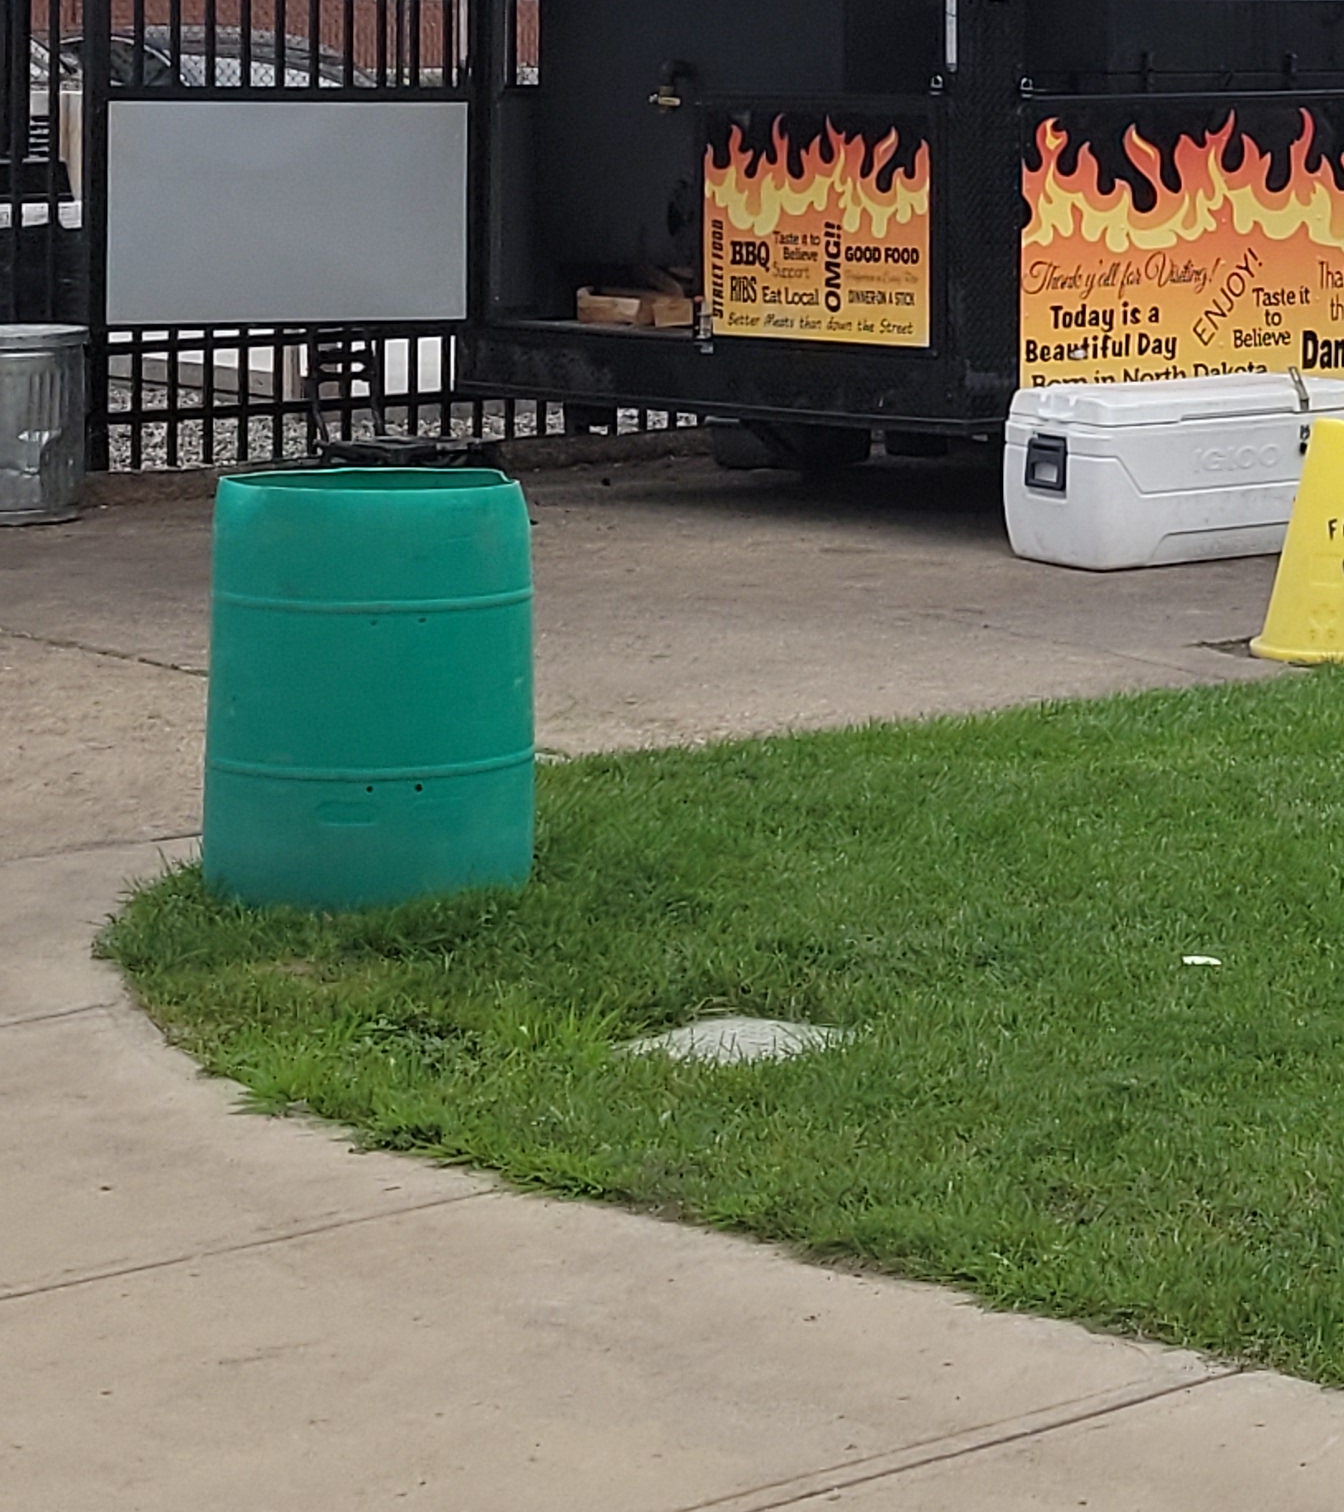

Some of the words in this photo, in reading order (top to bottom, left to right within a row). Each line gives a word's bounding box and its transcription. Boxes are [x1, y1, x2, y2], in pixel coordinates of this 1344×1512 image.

[730, 240, 770, 273] BBQ
[783, 247, 818, 262] Believe
[845, 246, 881, 263] GOOD
[884, 247, 920, 264] FOOD
[824, 221, 842, 313] OMG!!
[762, 286, 782, 305] Eat
[785, 287, 820, 306] Local
[1193, 248, 1263, 346] ENJOY!
[1252, 288, 1296, 307] Taste
[1299, 286, 1310, 305] it
[1050, 303, 1115, 332] Today
[1122, 301, 1141, 326] is
[1148, 306, 1160, 324] a
[1265, 309, 1282, 327] to
[1025, 333, 1130, 363] Beautiful
[1137, 333, 1177, 361] Day
[1233, 329, 1291, 348] Believe
